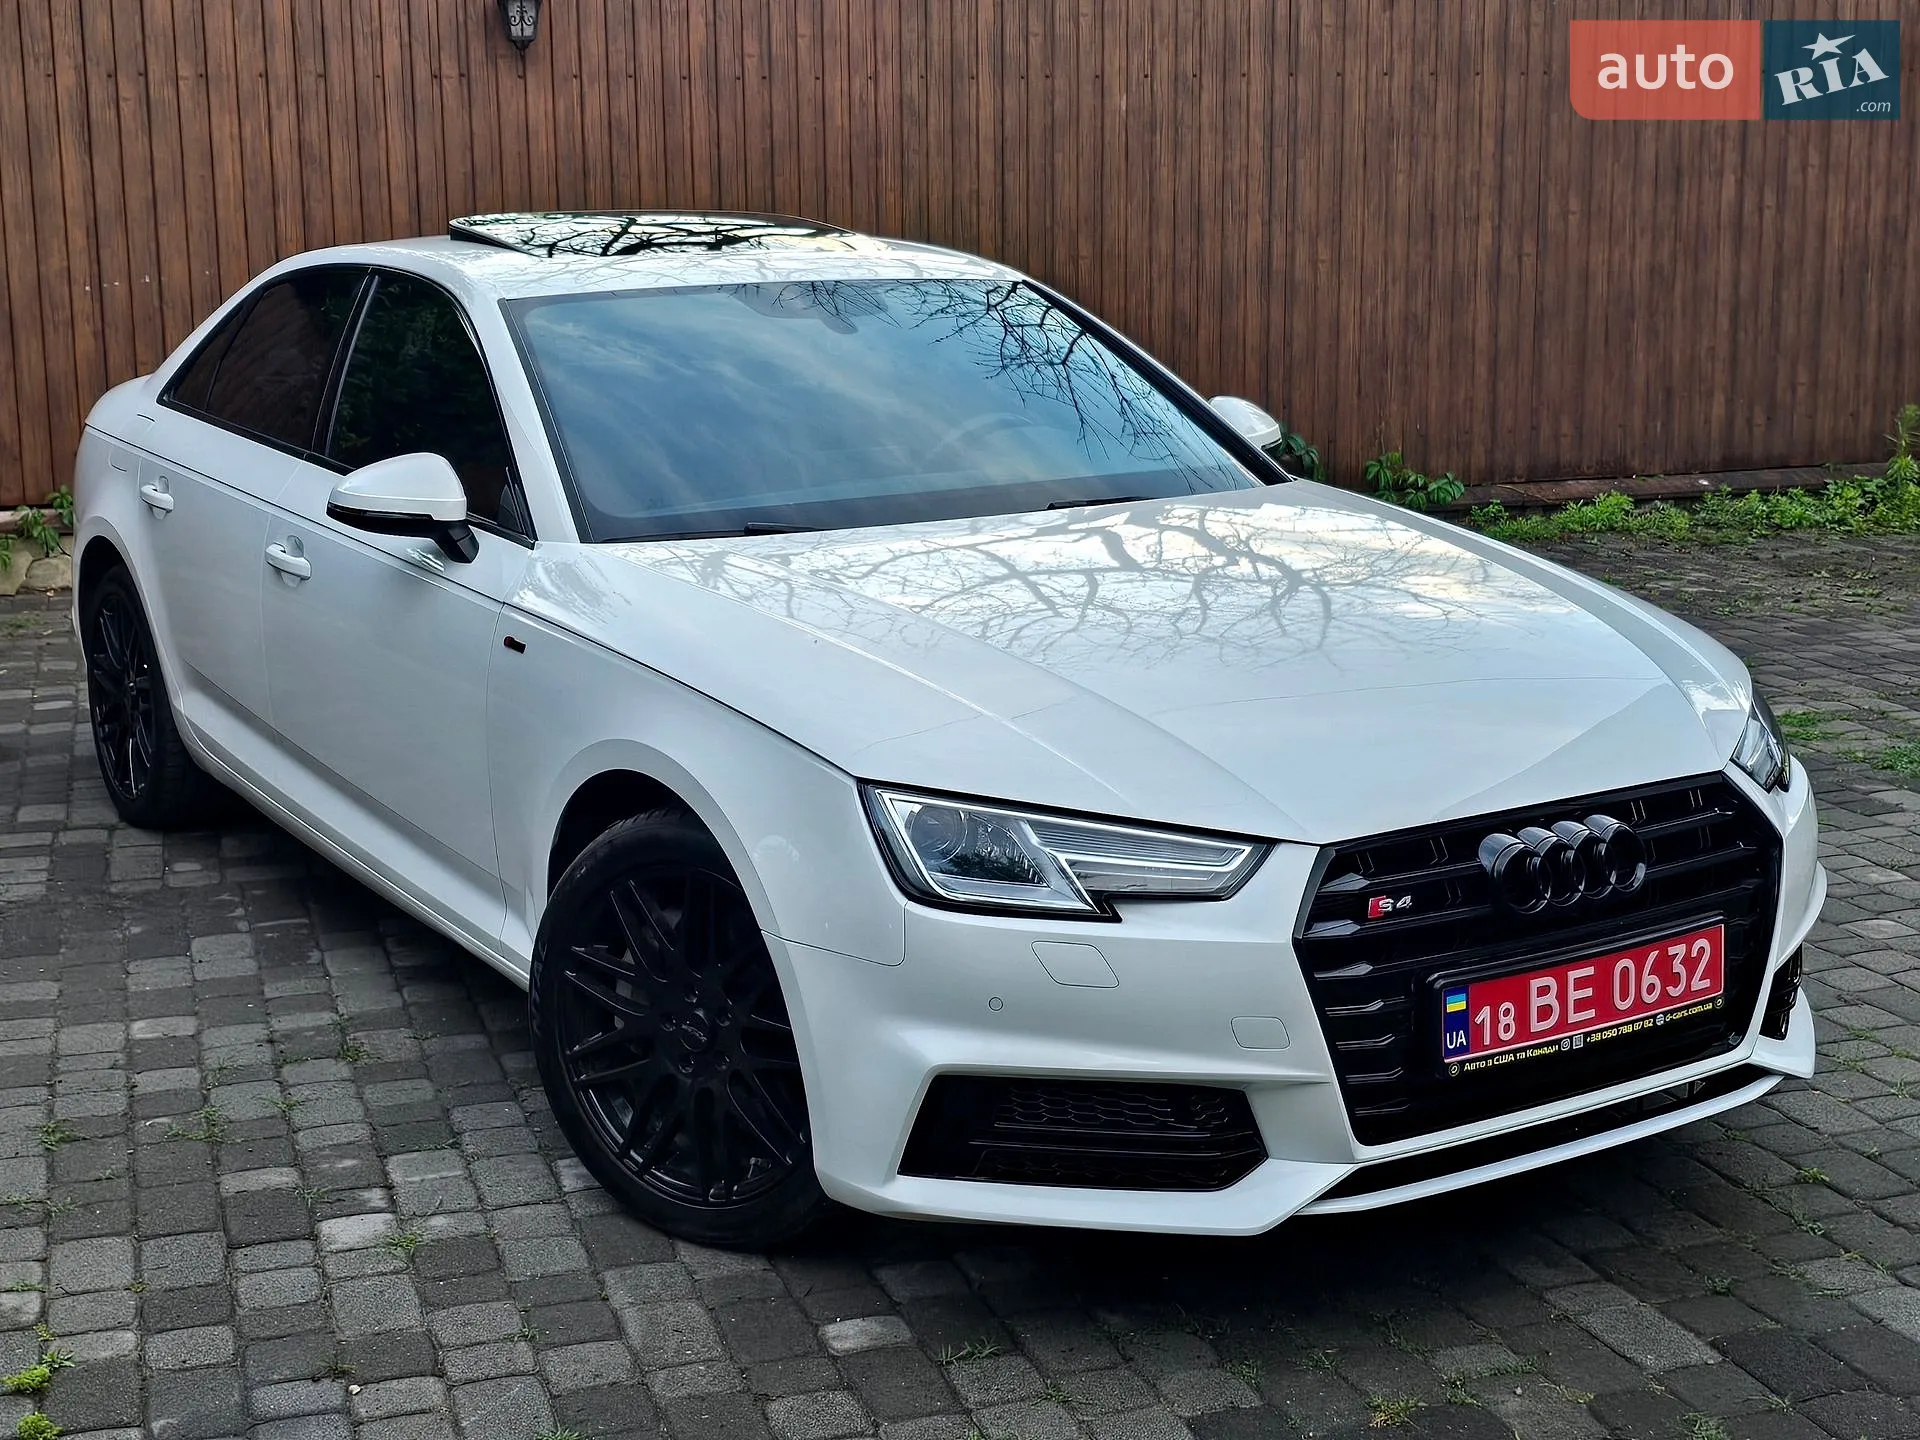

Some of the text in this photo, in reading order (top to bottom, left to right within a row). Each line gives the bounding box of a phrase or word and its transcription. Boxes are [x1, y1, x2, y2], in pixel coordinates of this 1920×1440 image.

[1368, 895, 1412, 918] S4
[1474, 938, 1711, 1046] 18 BE 0632
[1446, 1030, 1467, 1049] UA
[1493, 1052, 1515, 1065] США
